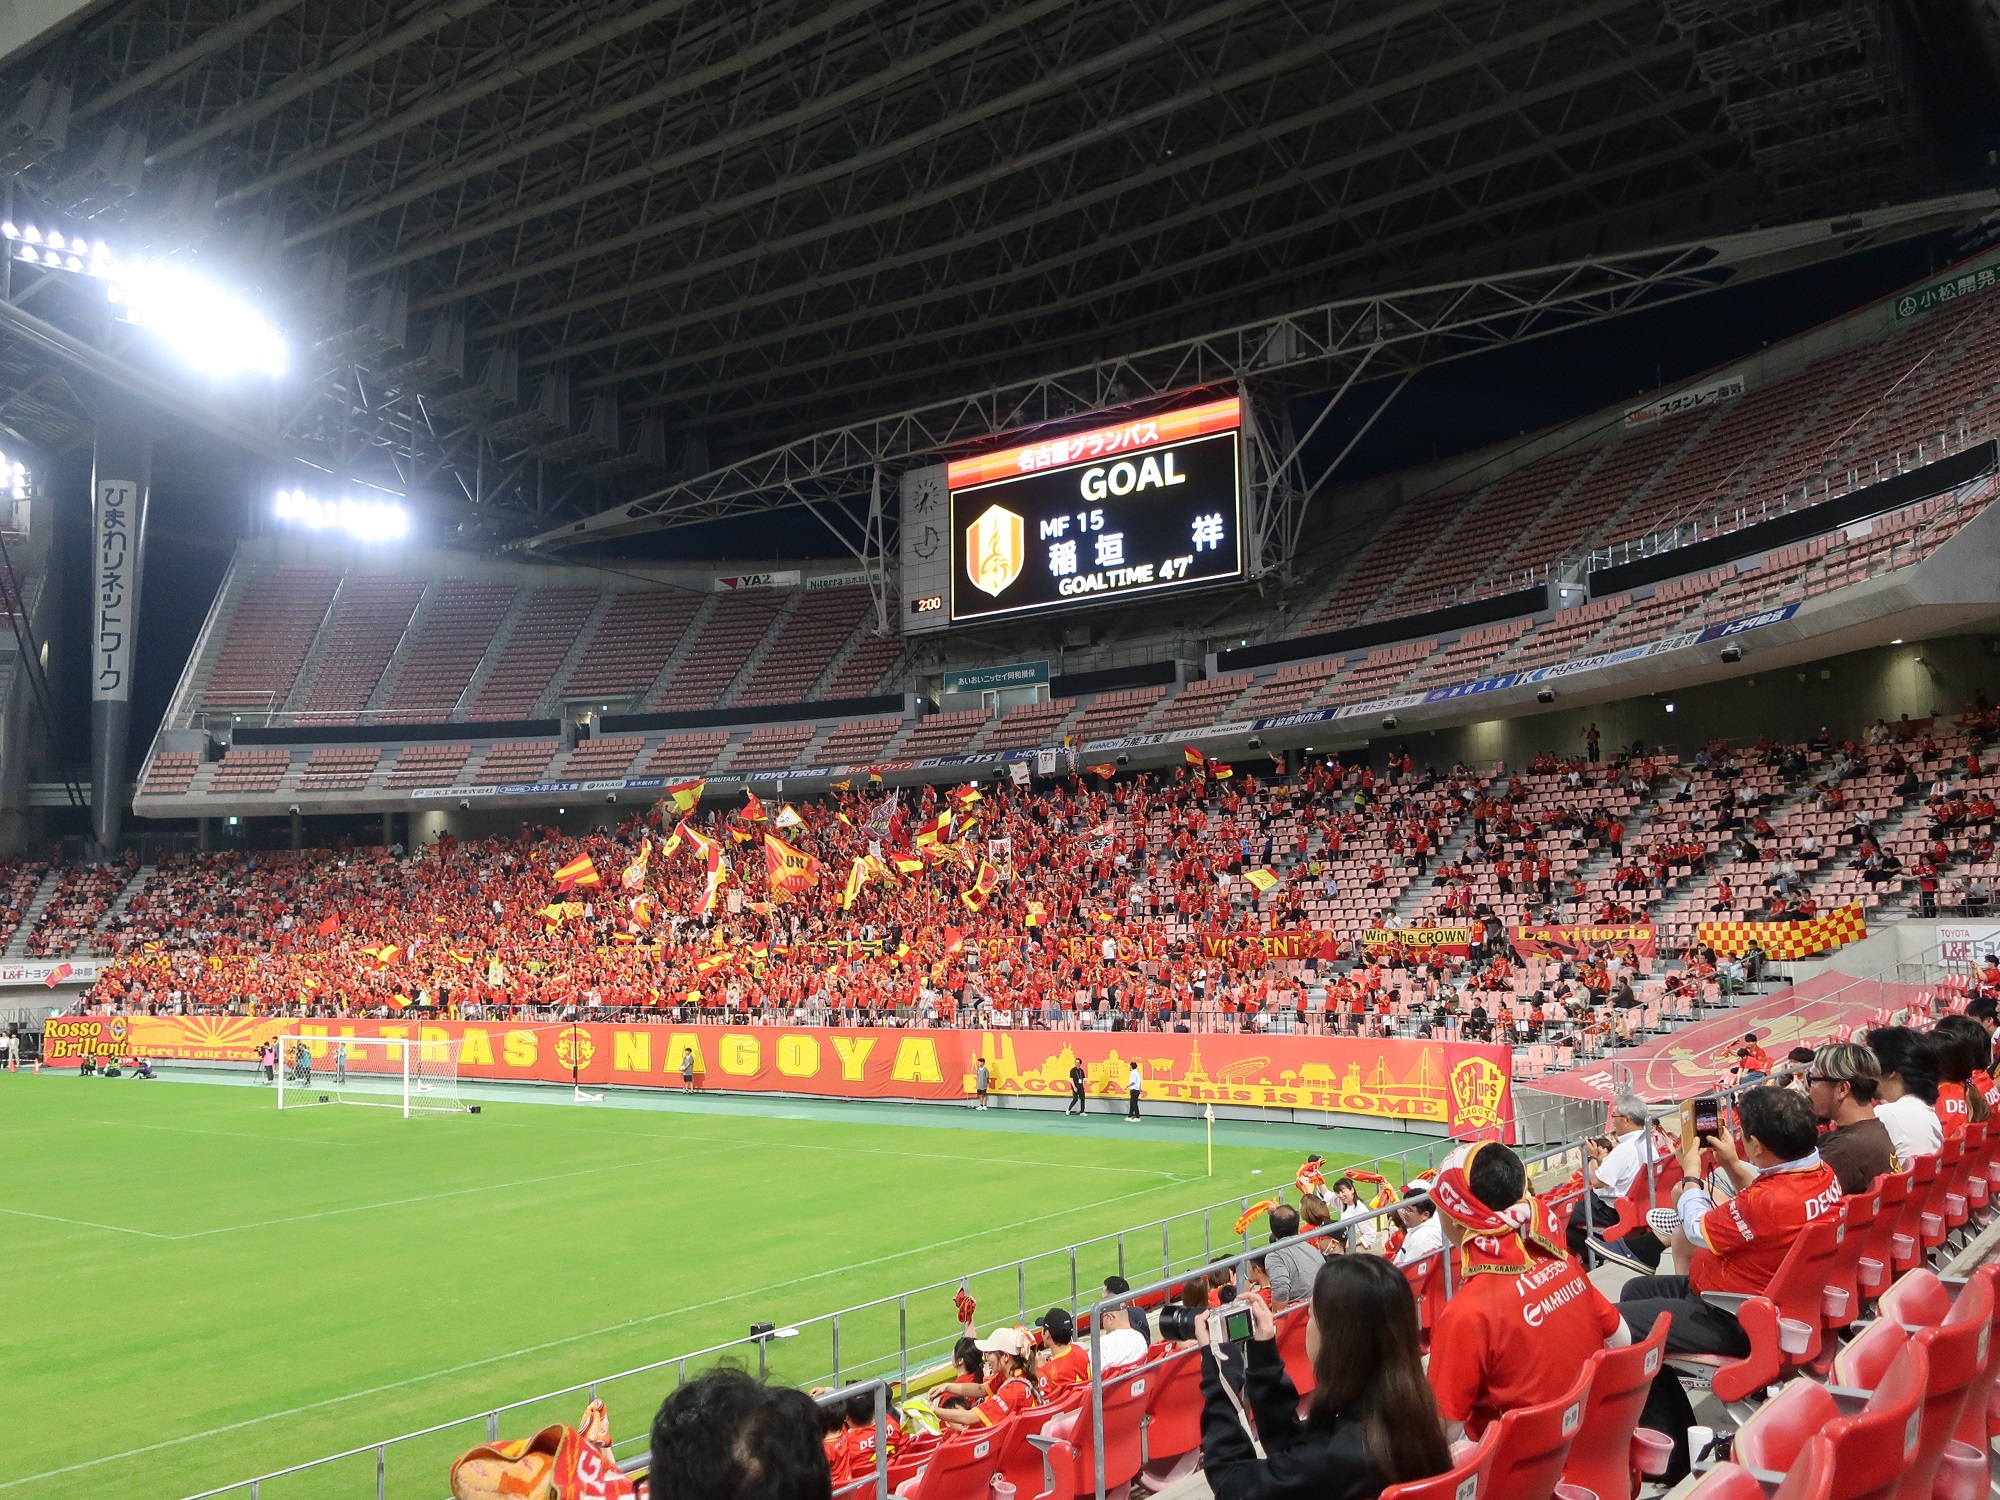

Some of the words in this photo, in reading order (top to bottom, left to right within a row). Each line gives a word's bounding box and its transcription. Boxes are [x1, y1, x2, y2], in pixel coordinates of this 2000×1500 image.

[1920, 266, 2000, 308] 小松開発
[1017, 421, 1160, 472] 名古屋グランパス
[1080, 452, 1186, 501] GOAL
[1040, 516, 1070, 541] MF
[1076, 510, 1105, 533] 15
[1191, 513, 1225, 552] 祥
[810, 578, 843, 589] Niterra
[1058, 563, 1154, 596] GOALTIME
[99, 487, 129, 692] ひまわりネットワーク
[918, 597, 942, 612] 2:00
[957, 668, 1036, 686] あいおいニッセイ同和損保
[1119, 733, 1164, 747] 万能工業
[848, 761, 913, 773] キョウエイファイン
[963, 753, 996, 764] FTS
[753, 770, 789, 781] TOYO
[790, 768, 829, 778] TIRES
[595, 782, 623, 790] TAKAGI
[1365, 930, 1388, 941] Win
[1418, 930, 1466, 944] CROWN
[1516, 925, 1551, 941] La
[1559, 924, 1651, 942] vittoria
[1941, 929, 1970, 938] TOYOTA
[1942, 941, 1971, 960] L&F
[3, 970, 24, 980] L&F
[44, 1019, 102, 1039] Rosso
[131, 1045, 169, 1057] Here
[177, 1044, 191, 1057] is
[194, 1048, 223, 1059] our
[299, 1024, 539, 1067] ULTRAS
[613, 1030, 944, 1084] NAGOYA
[1159, 1083, 1252, 1101] This
[1263, 1088, 1298, 1104] is
[1309, 1091, 1439, 1117] HOME
[1459, 1107, 1496, 1120] NAGOYA
[1532, 1260, 1568, 1287] 東海ろうきん
[1540, 1276, 1587, 1315] MARUICHI
